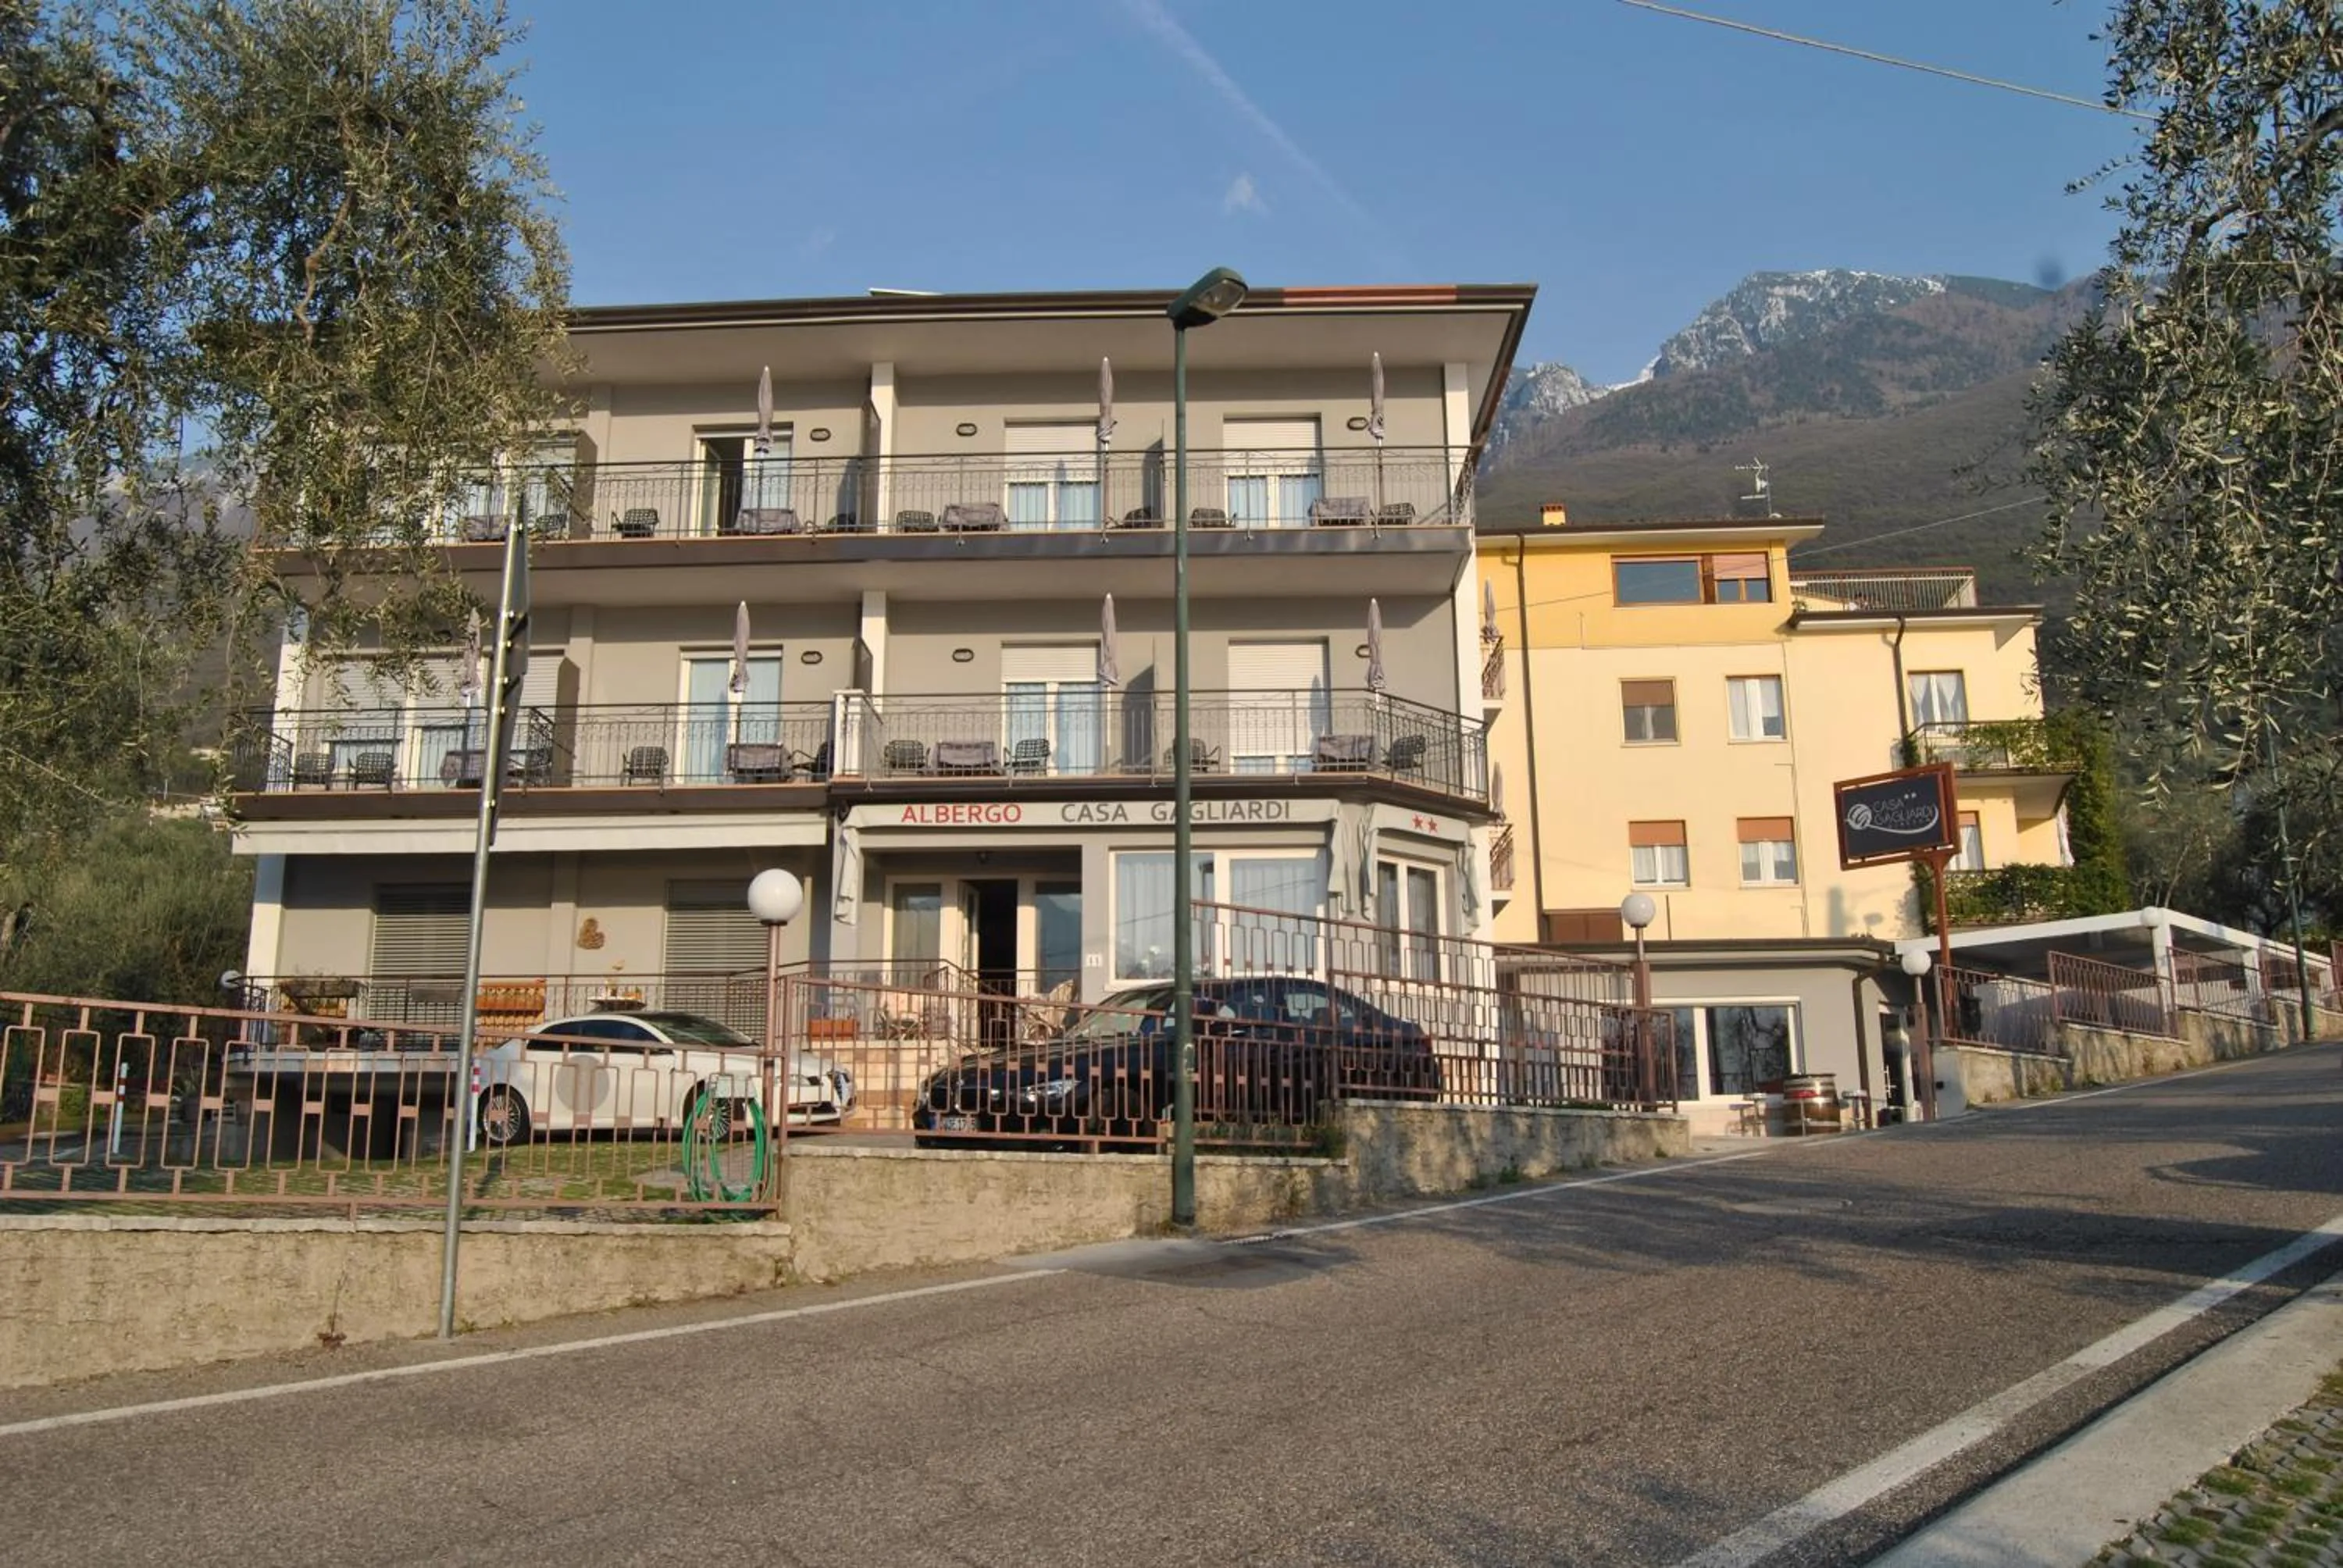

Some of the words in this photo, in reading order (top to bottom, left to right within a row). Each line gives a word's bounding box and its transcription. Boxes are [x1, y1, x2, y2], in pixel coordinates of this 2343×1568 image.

[900, 804, 1022, 824] ALBERGO
[1061, 803, 1129, 822] CASA
[1150, 800, 1290, 821] GGLIARDI
[1873, 798, 1904, 812] CASA
